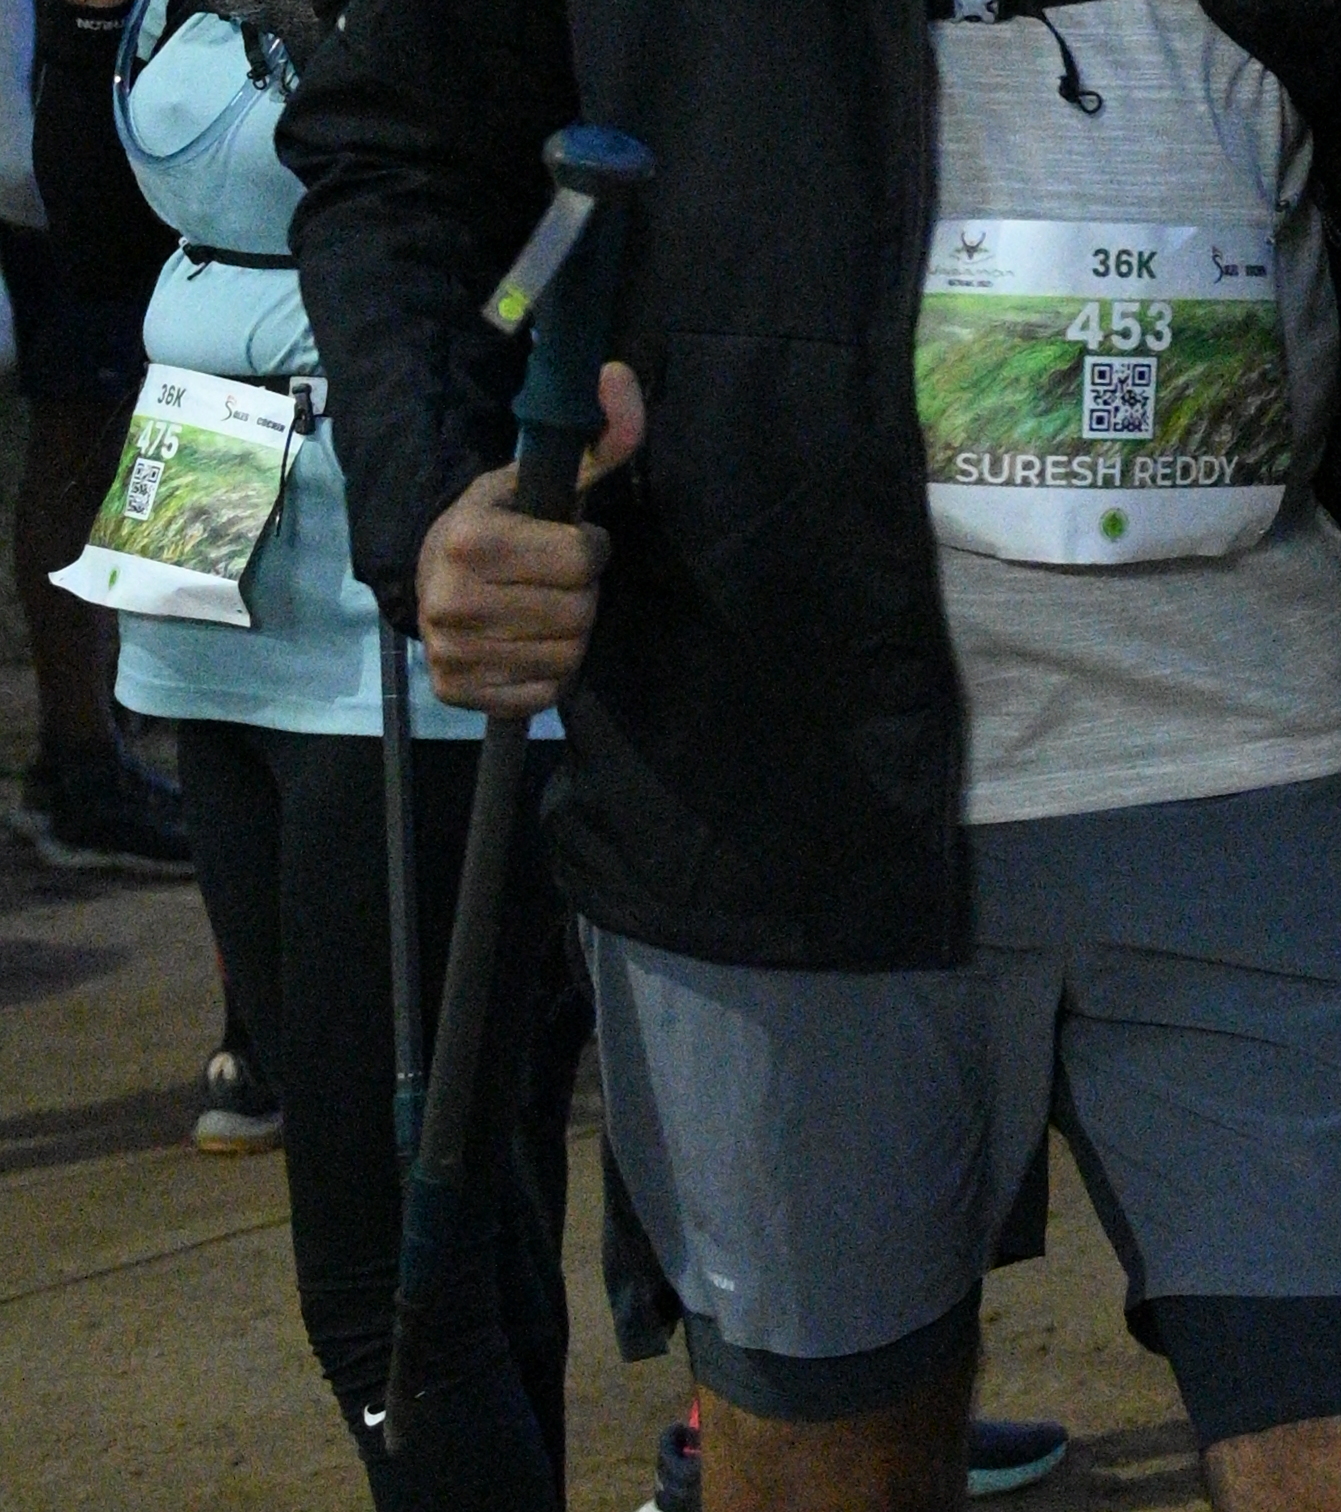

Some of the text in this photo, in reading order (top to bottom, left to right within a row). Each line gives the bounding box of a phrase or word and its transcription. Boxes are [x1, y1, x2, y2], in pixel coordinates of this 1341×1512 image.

[1091, 247, 1158, 280] 36K
[1065, 301, 1173, 352] 453
[157, 383, 187, 409] 36K
[136, 420, 184, 460] 475
[955, 453, 1240, 487] SURESH REDDY
